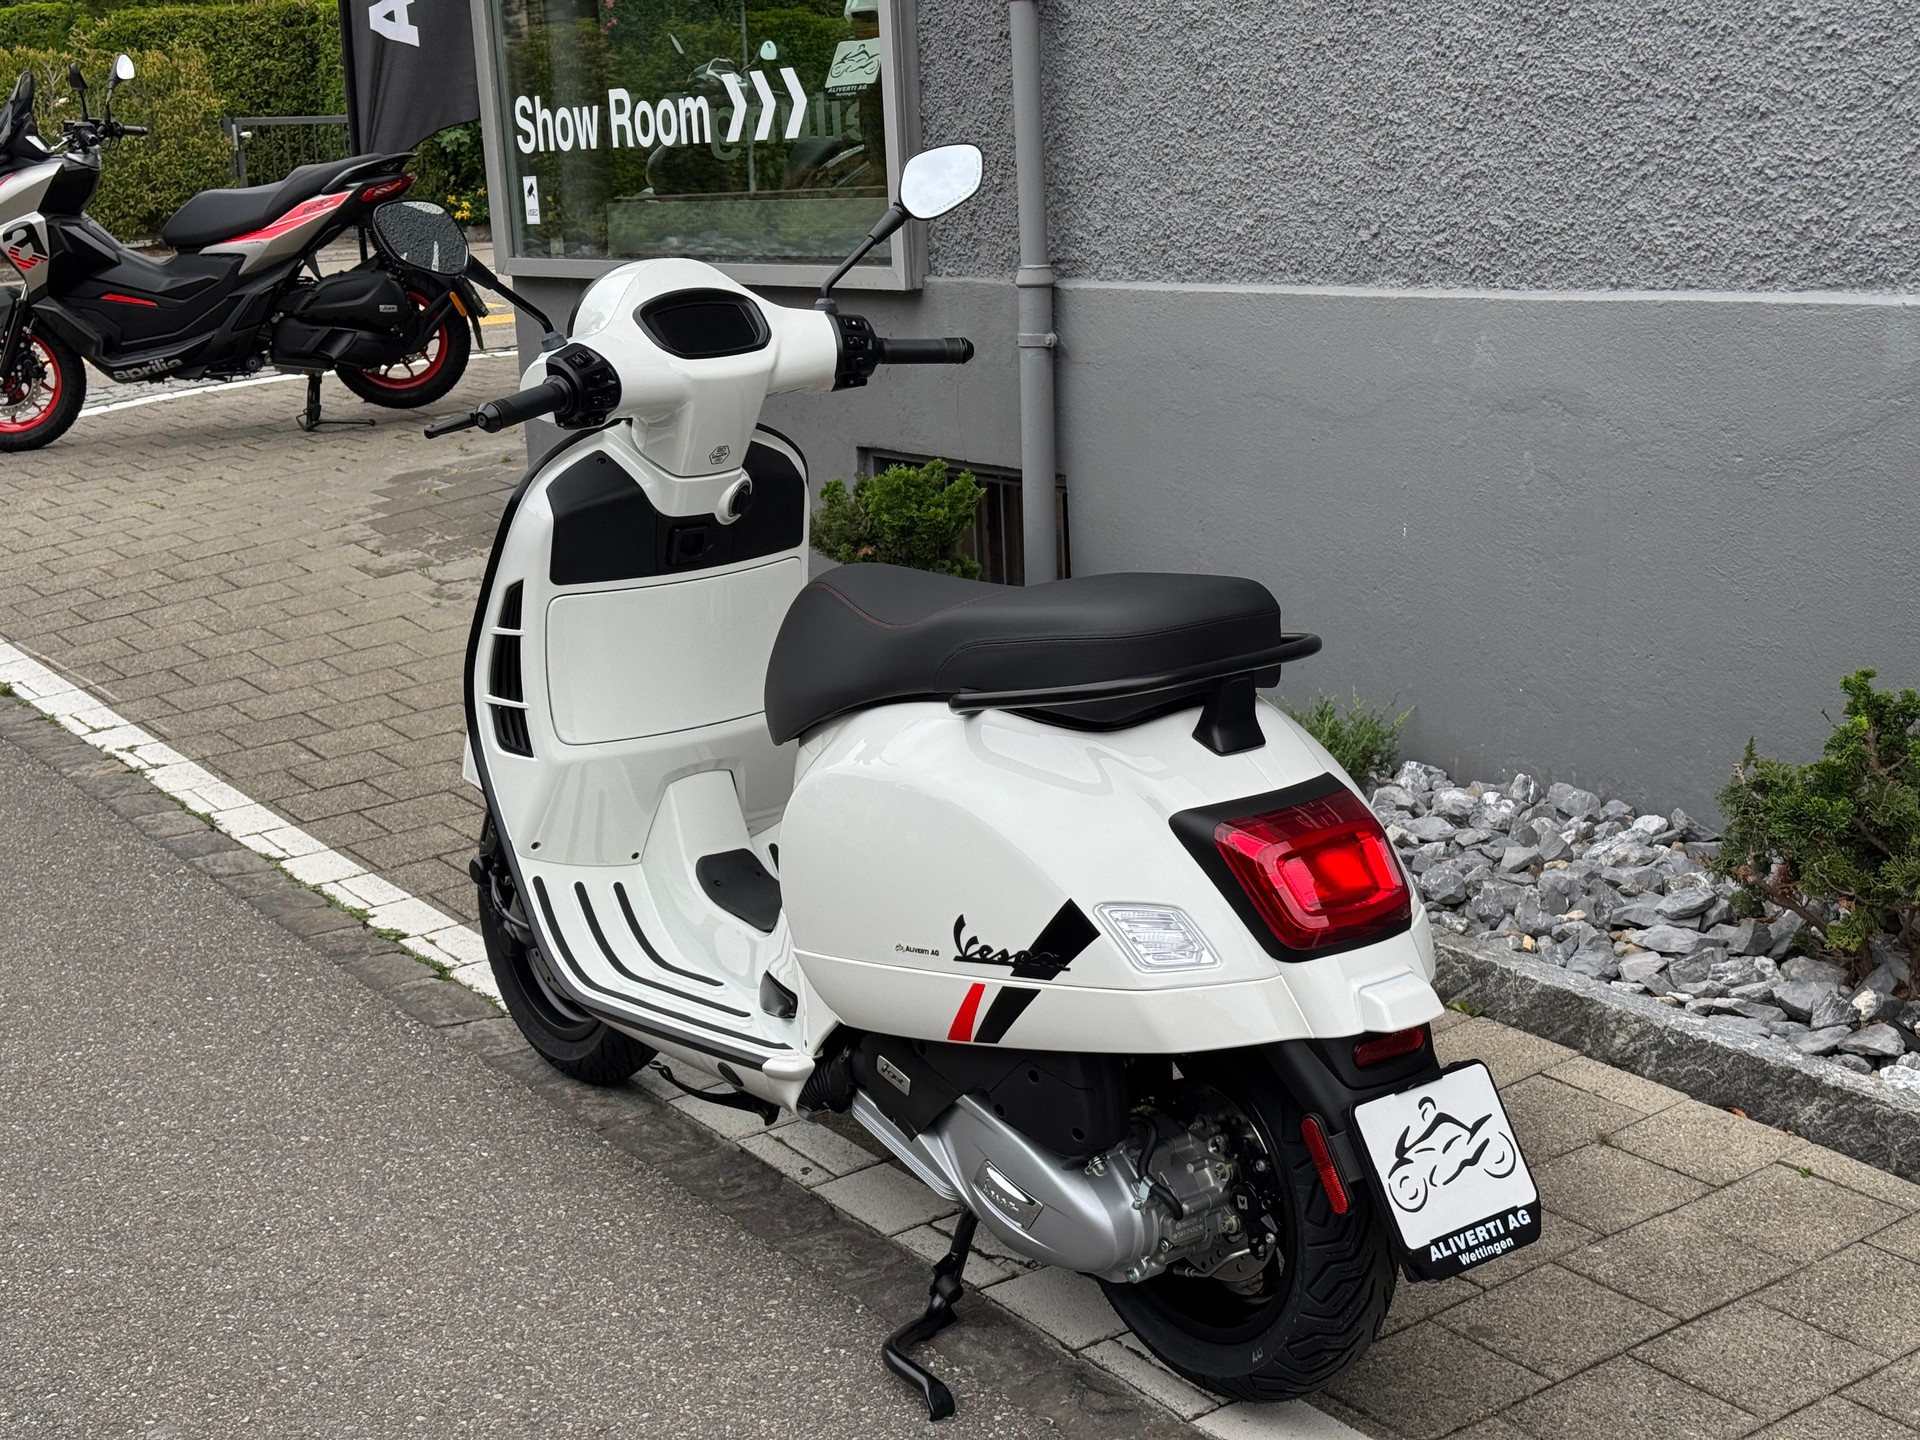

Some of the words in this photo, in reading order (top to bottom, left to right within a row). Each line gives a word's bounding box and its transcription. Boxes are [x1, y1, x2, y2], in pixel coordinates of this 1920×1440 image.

[514, 95, 599, 154] Show
[608, 87, 712, 149] Room
[112, 358, 184, 380] aprilia
[905, 945, 929, 956] ALIVERTI
[930, 949, 940, 957] AG
[953, 914, 1071, 972] Vespa
[1429, 1219, 1505, 1263] ALIVERTI
[1507, 1209, 1532, 1231] AG
[1458, 1236, 1515, 1267] Wettingen
